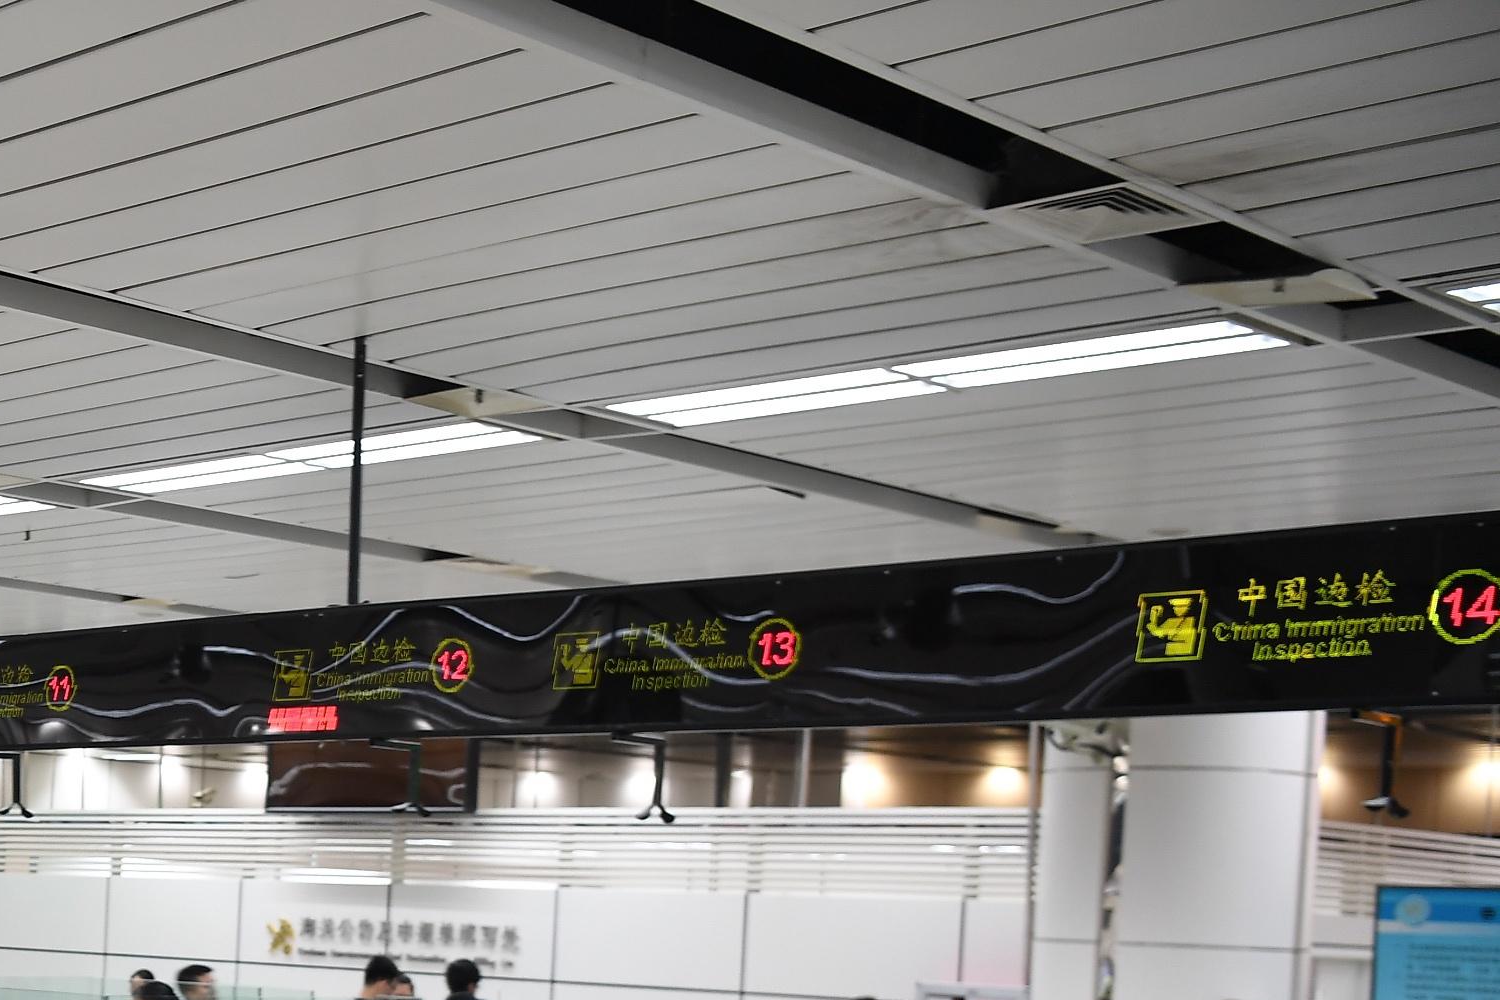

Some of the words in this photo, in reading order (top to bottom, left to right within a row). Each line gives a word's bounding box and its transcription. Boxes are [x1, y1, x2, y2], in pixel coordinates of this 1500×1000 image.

[1238, 569, 1396, 616] 中国边检
[1443, 586, 1500, 626] 14
[622, 617, 727, 653] 中国边检
[1212, 621, 1281, 642] China
[1285, 614, 1425, 640] Immigration
[328, 637, 416, 669] 中国边检
[758, 632, 797, 666] 13
[1252, 638, 1372, 662] Inspection
[437, 650, 469, 680] 12
[604, 657, 647, 674] China
[652, 653, 745, 673] Immigration
[49, 676, 70, 701] 11
[316, 671, 350, 687] China
[353, 669, 429, 687] Immigration
[632, 674, 709, 692] Inspection
[338, 687, 402, 704] Inspection
